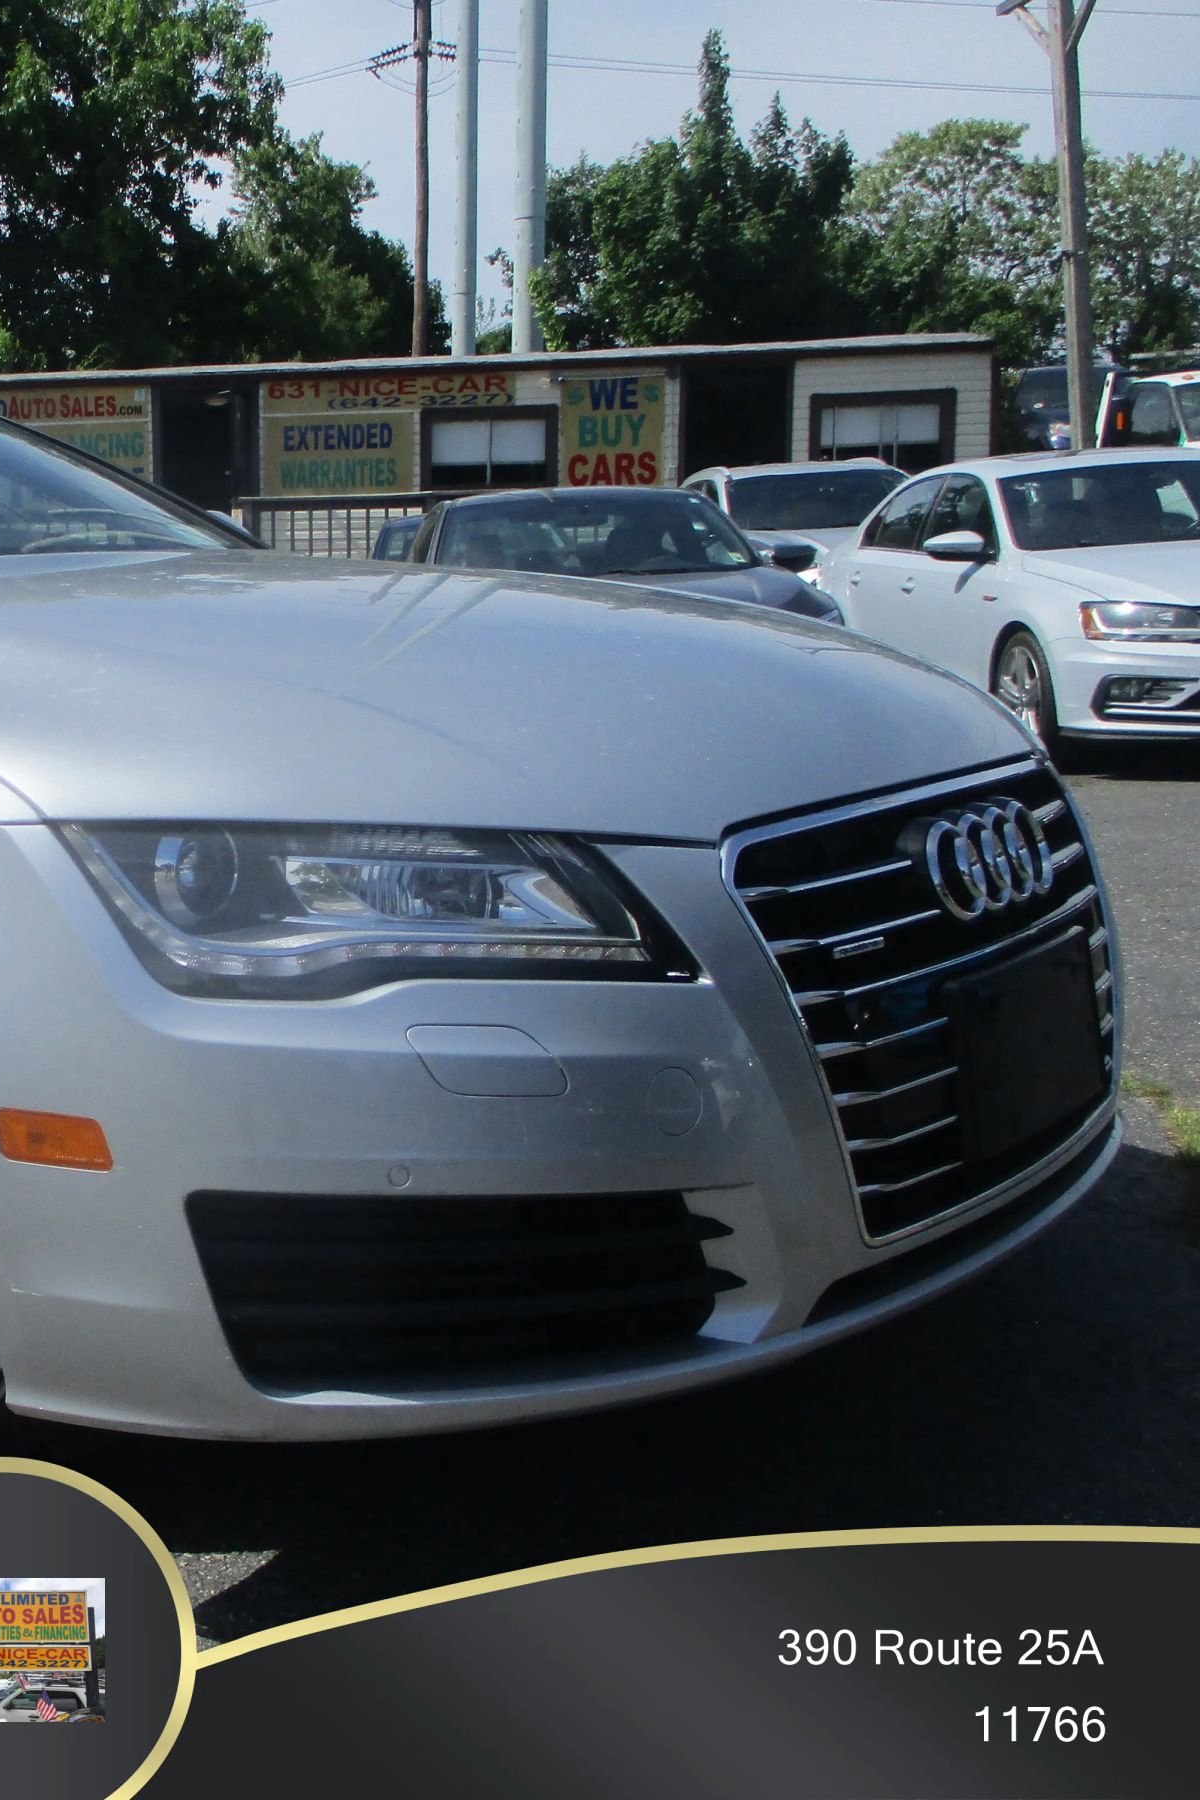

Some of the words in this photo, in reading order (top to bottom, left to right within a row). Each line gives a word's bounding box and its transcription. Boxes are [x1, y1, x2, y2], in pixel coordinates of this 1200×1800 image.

[267, 376, 507, 399] 631-NICE-CAR
[588, 378, 639, 411] WE
[283, 422, 393, 452] EXTENDED
[578, 414, 647, 448] BUY
[281, 456, 398, 489] WARRANTIES
[567, 451, 657, 487] CARS
